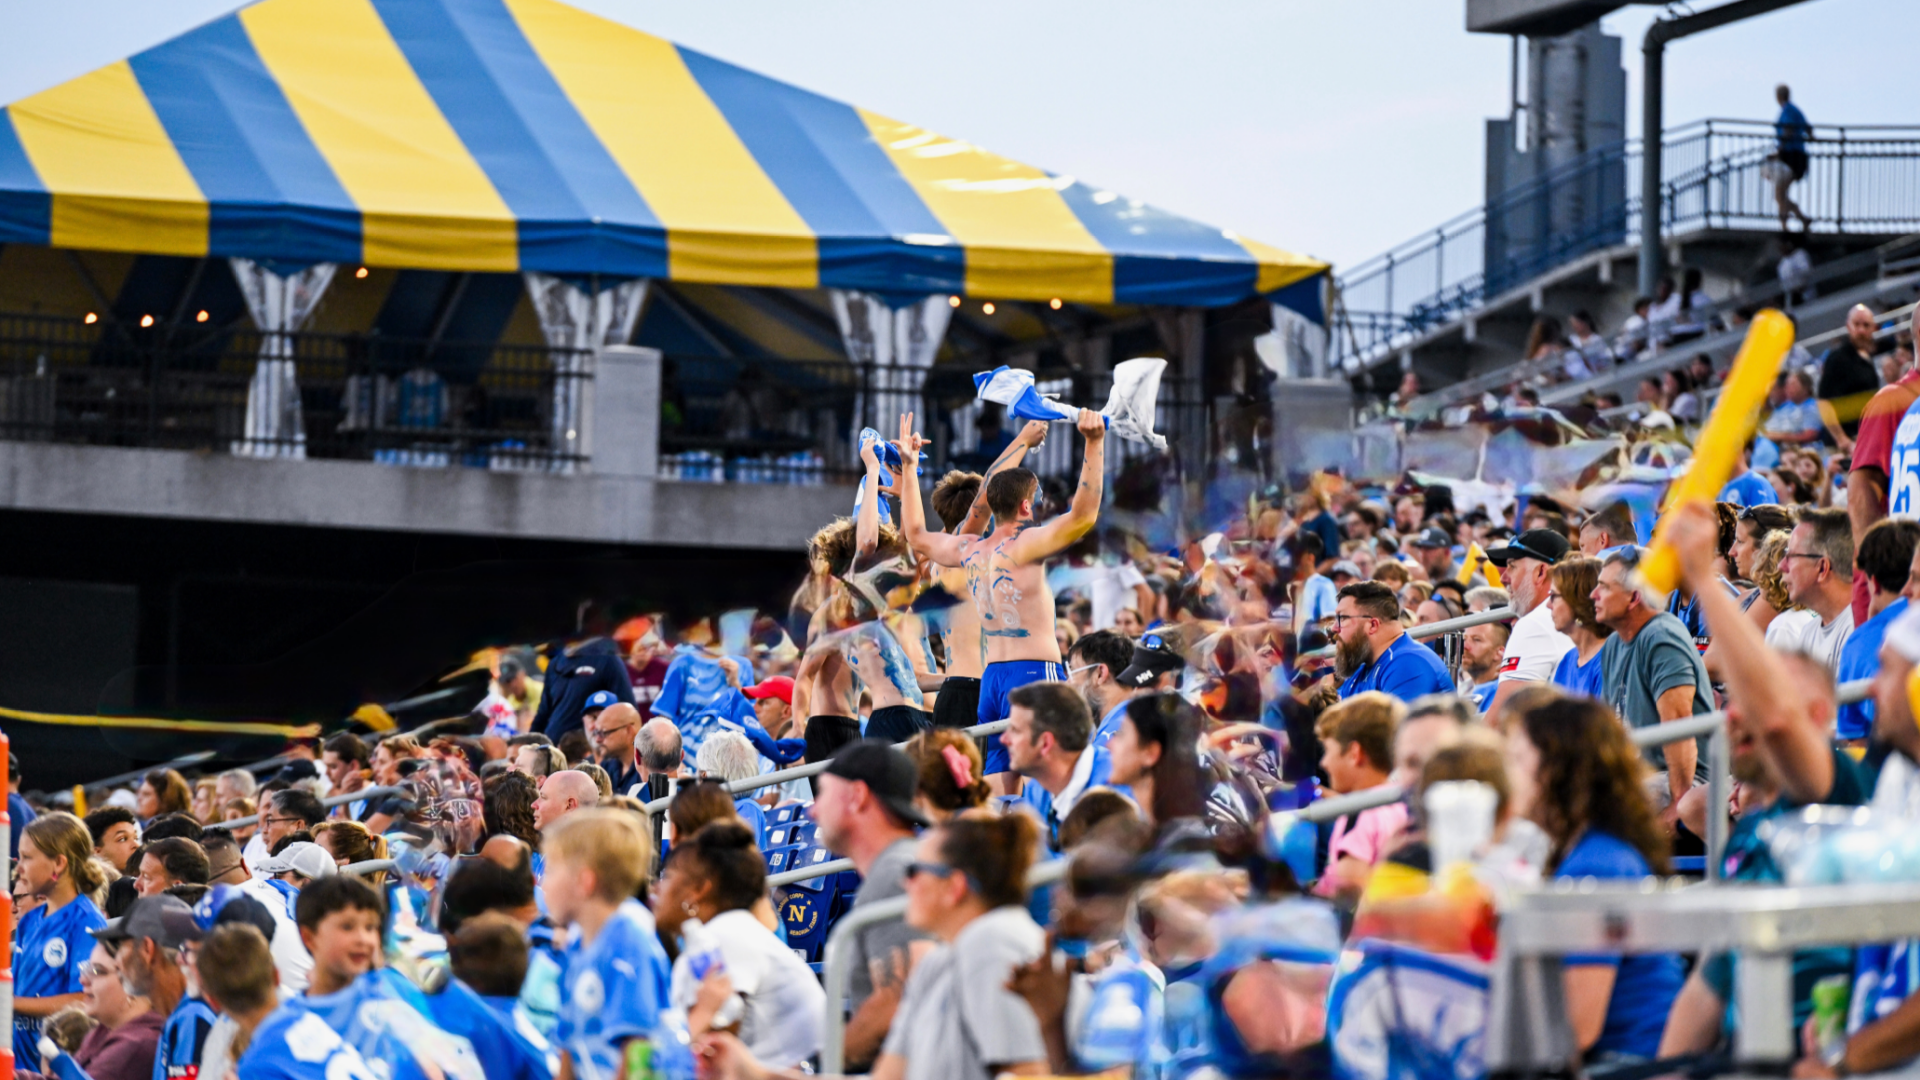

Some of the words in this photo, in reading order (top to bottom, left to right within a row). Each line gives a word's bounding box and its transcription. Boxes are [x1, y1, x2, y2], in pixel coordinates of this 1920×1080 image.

[1889, 448, 1920, 522] 25
[1135, 669, 1154, 684] HH
[788, 905, 806, 922] N
